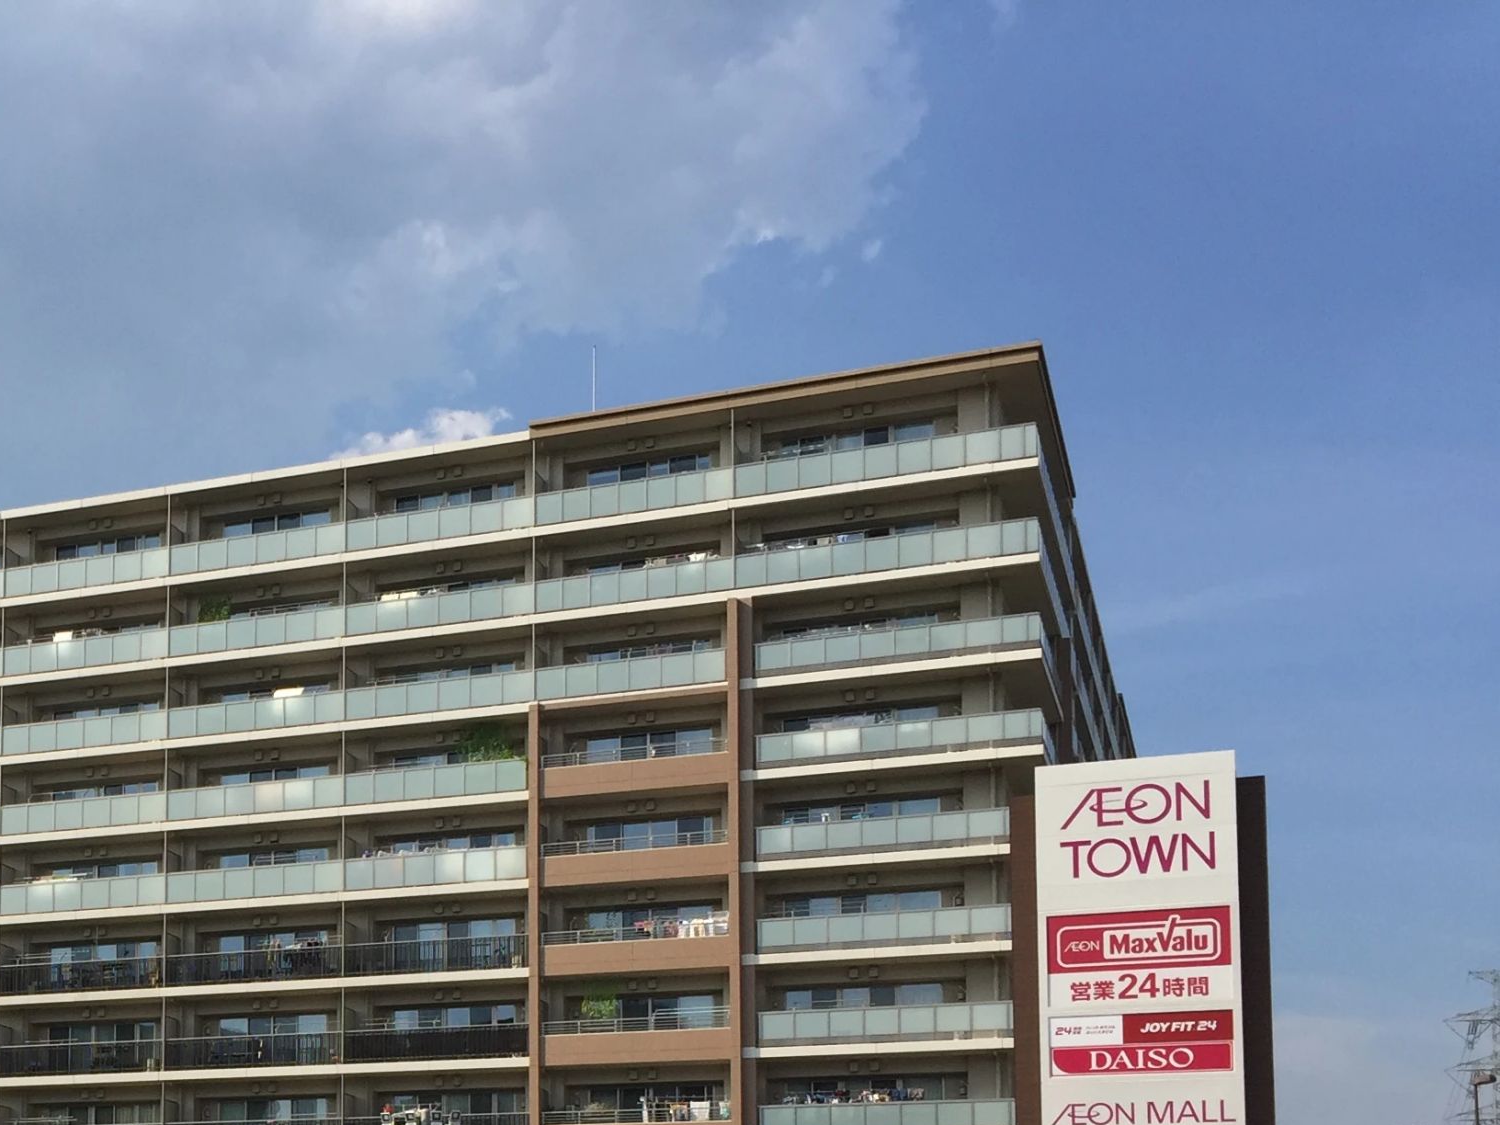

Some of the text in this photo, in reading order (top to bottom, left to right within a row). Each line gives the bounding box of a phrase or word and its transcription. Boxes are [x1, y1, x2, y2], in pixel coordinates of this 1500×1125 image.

[1060, 831, 1216, 879] TOWN
[1109, 914, 1208, 956] MaxValu
[1070, 973, 1210, 1002] 営業24時間
[1088, 1047, 1195, 1071] DAISO
[1147, 1099, 1237, 1124] MALL
